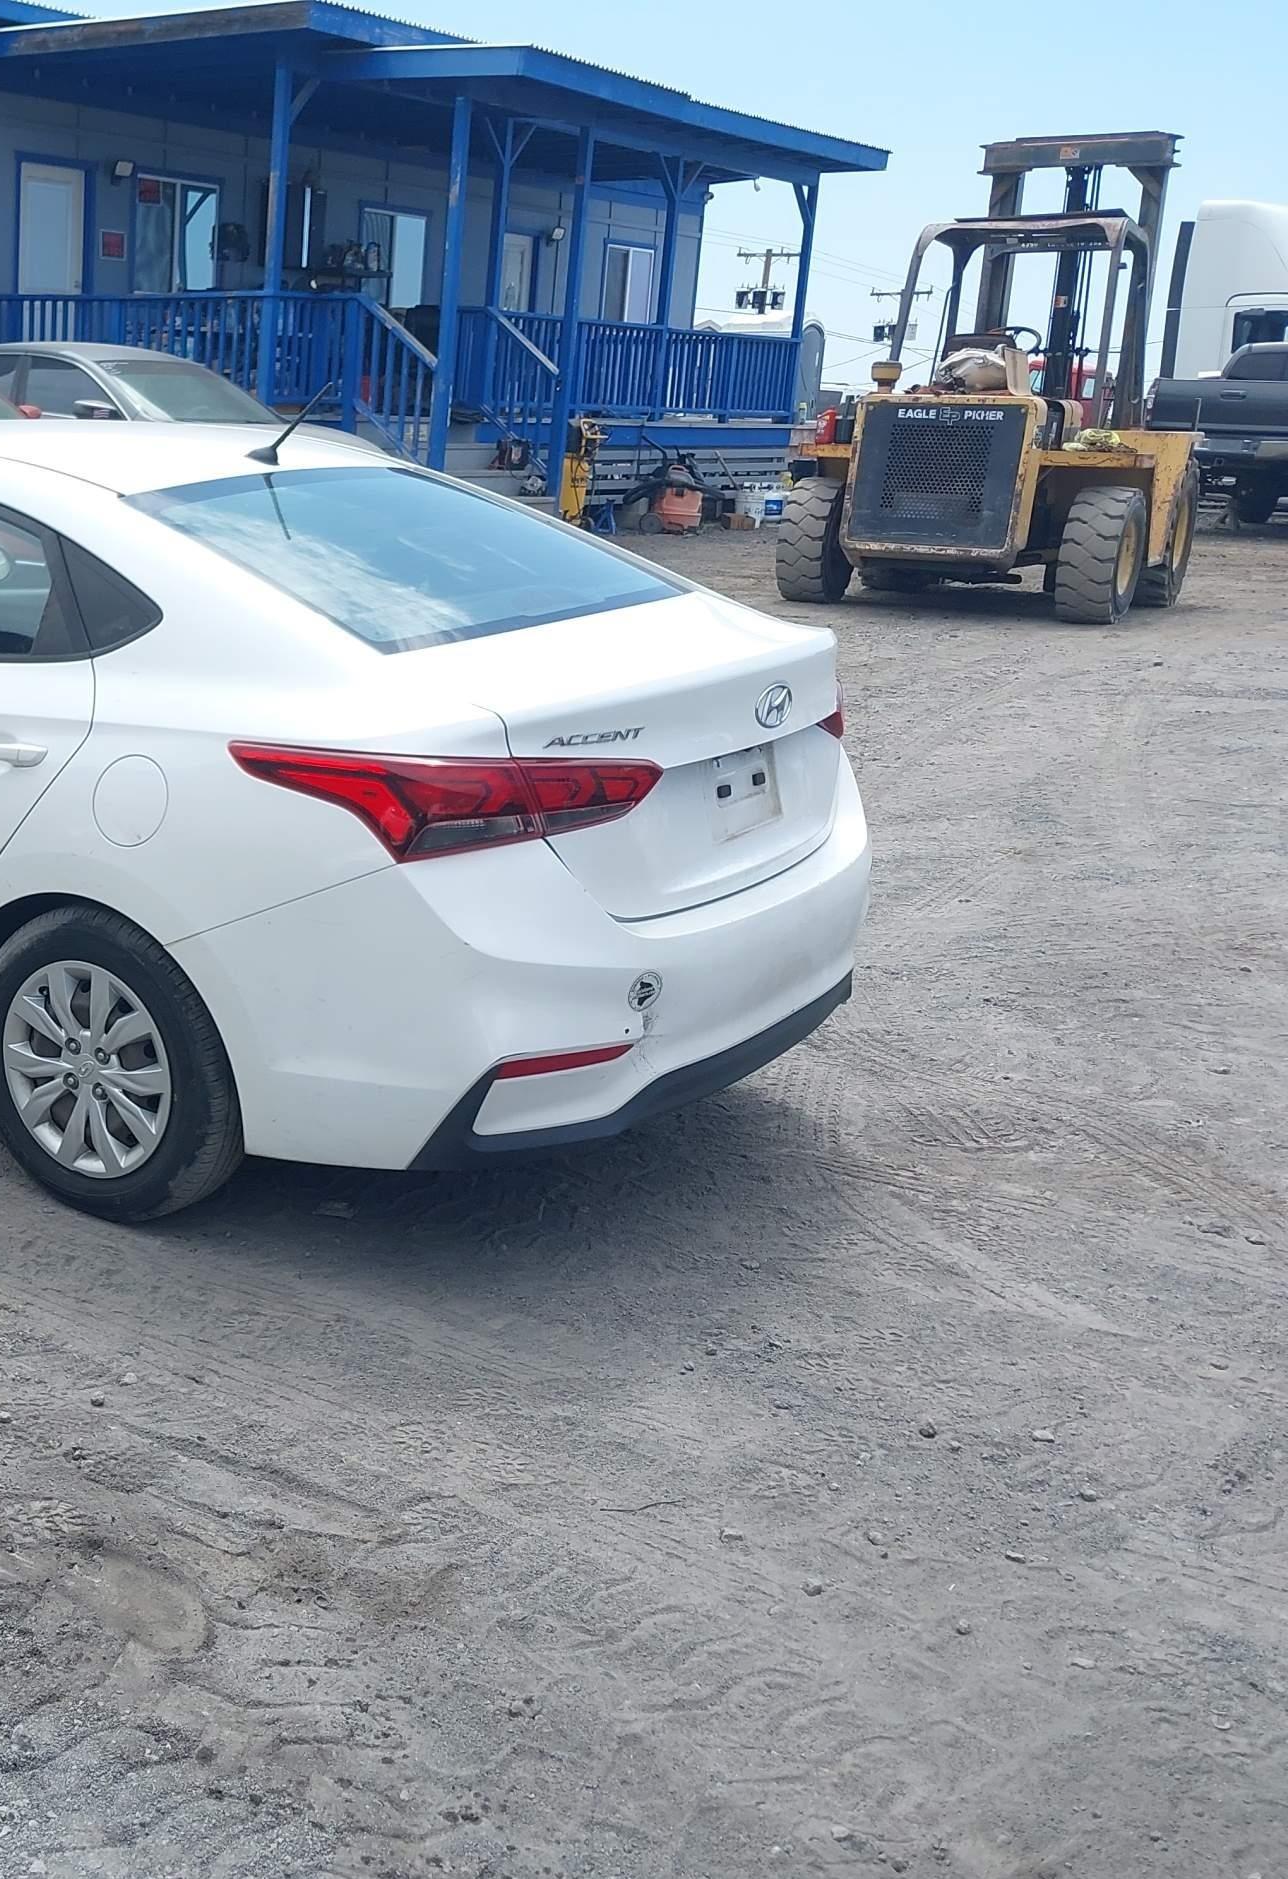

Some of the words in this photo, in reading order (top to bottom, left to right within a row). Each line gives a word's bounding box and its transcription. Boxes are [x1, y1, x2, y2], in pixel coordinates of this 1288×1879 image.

[897, 408, 937, 419] EAGLE
[964, 410, 1005, 420] PICHER
[543, 726, 645, 748] ACCENT
